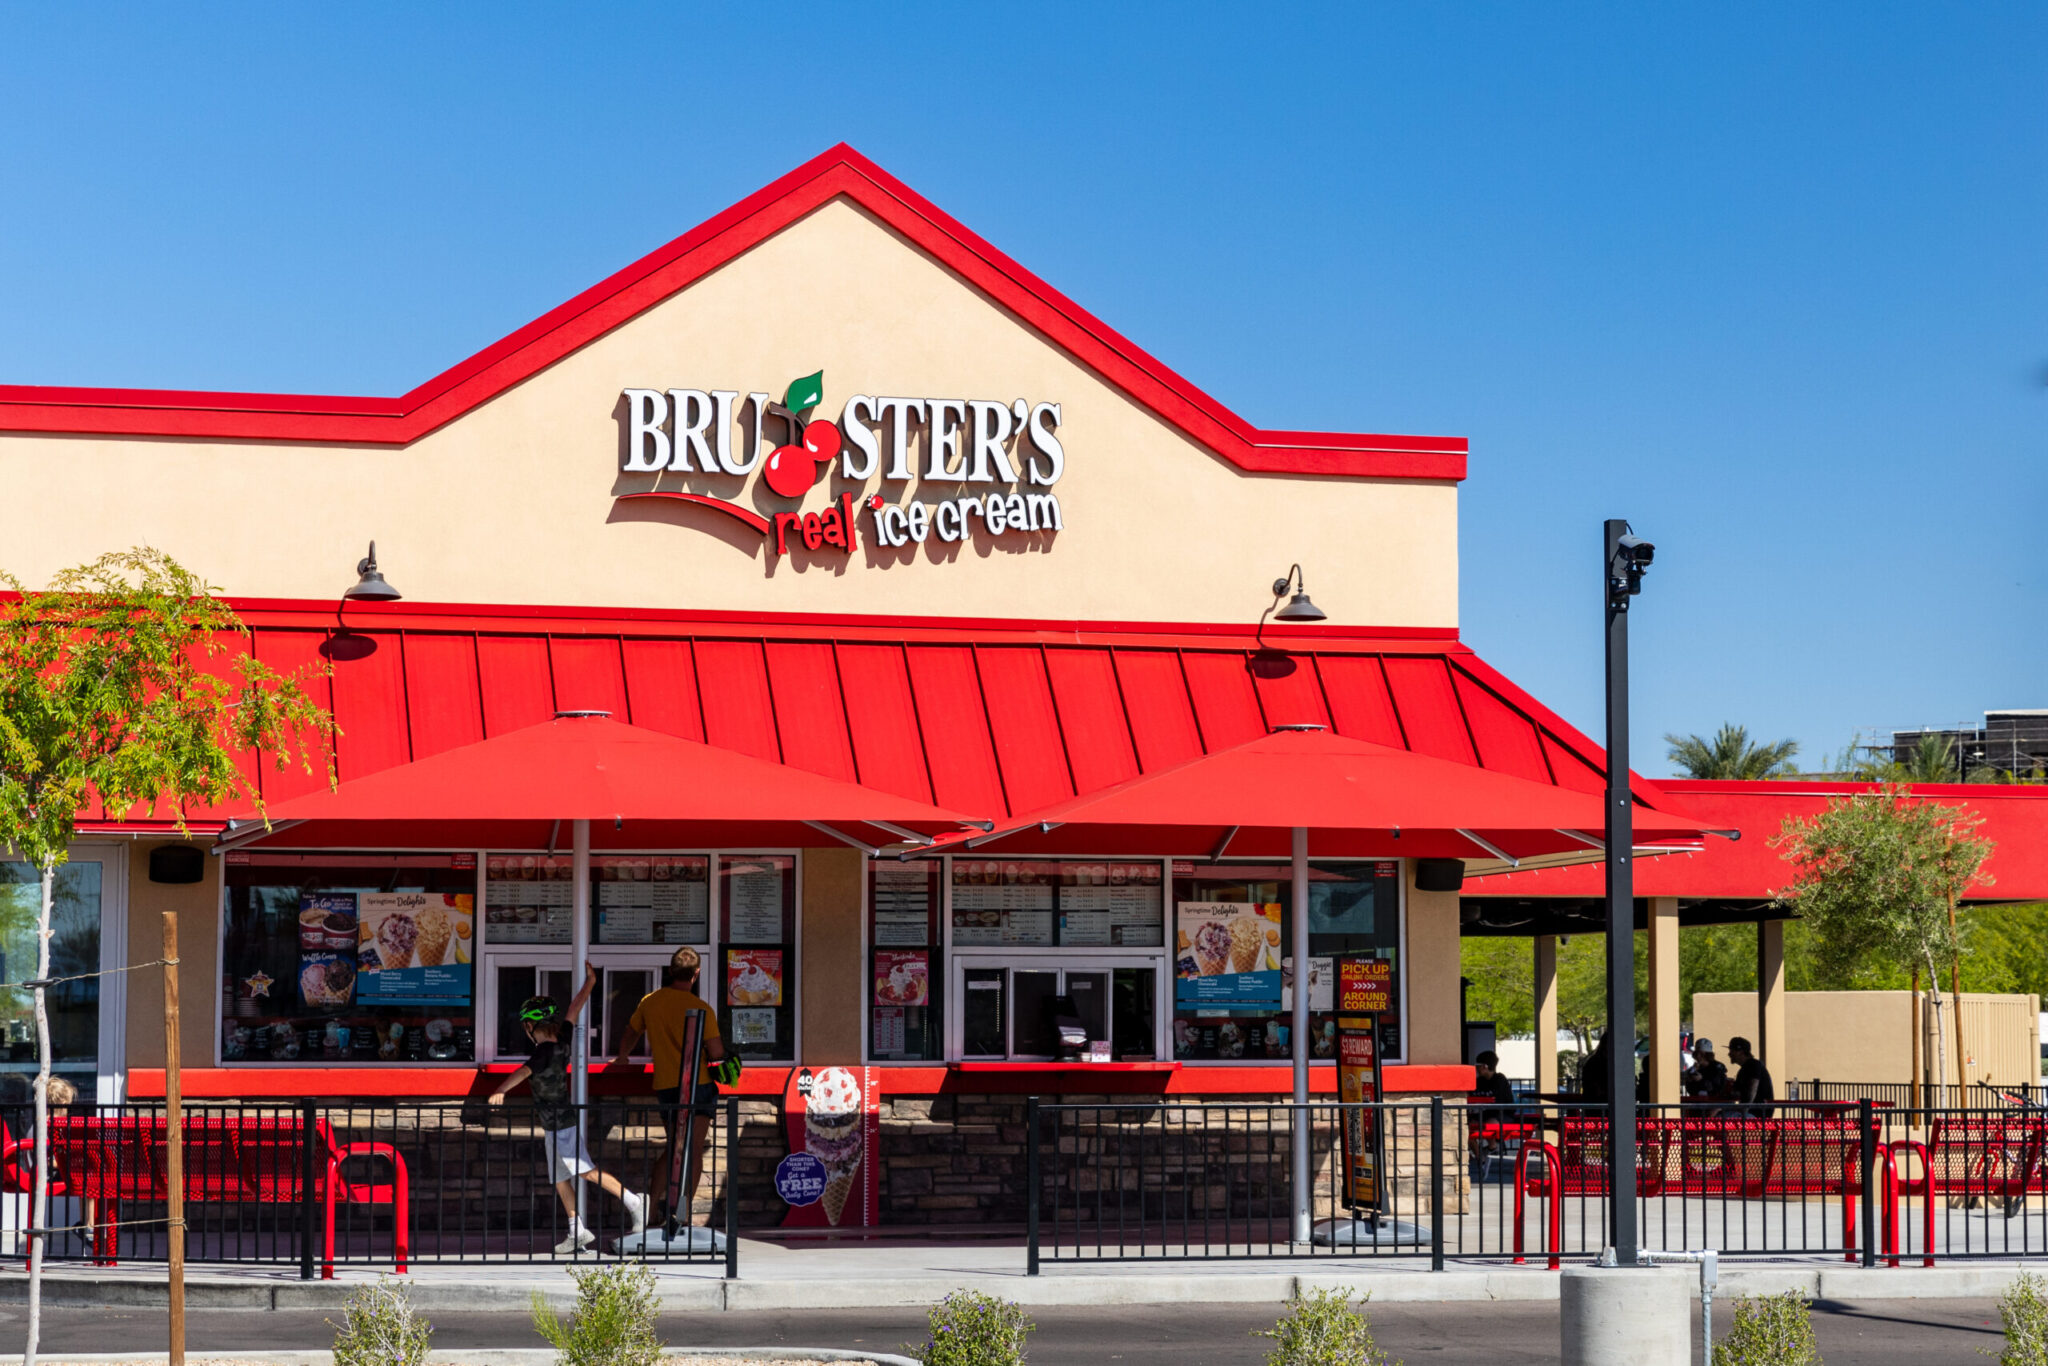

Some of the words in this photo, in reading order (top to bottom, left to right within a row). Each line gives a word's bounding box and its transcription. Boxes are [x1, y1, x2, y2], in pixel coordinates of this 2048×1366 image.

[773, 491, 858, 555] real
[868, 494, 930, 548] ice
[936, 491, 1064, 543] cream
[309, 899, 320, 909] To
[320, 898, 332, 908] Go
[396, 895, 427, 908] Delights
[1211, 904, 1239, 917] Delights
[1342, 964, 1370, 975] PICK
[1372, 964, 1389, 975] UP
[1343, 992, 1388, 1001] AROUND
[1344, 1001, 1387, 1010] CORNER
[1342, 1036, 1349, 1056] $3
[1348, 1038, 1373, 1056] REWARD
[798, 1075, 814, 1085] 40
[787, 1172, 799, 1180] Get
[780, 1178, 823, 1192] FREE
